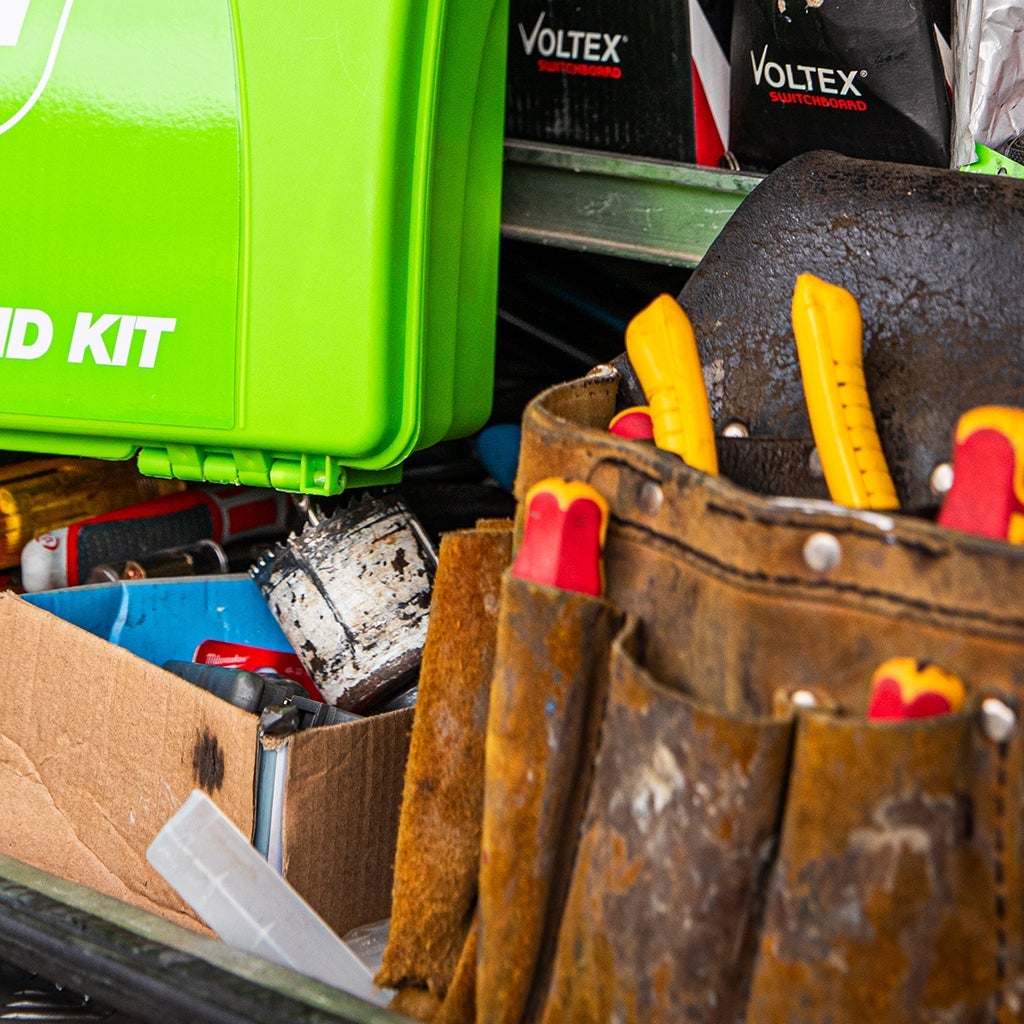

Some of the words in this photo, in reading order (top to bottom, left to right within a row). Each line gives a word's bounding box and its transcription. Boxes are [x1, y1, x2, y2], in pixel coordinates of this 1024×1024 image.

[537, 59, 622, 80] SWITCHBOARD
[768, 90, 868, 112] SWITCHBOARD
[67, 311, 177, 369] KIT
